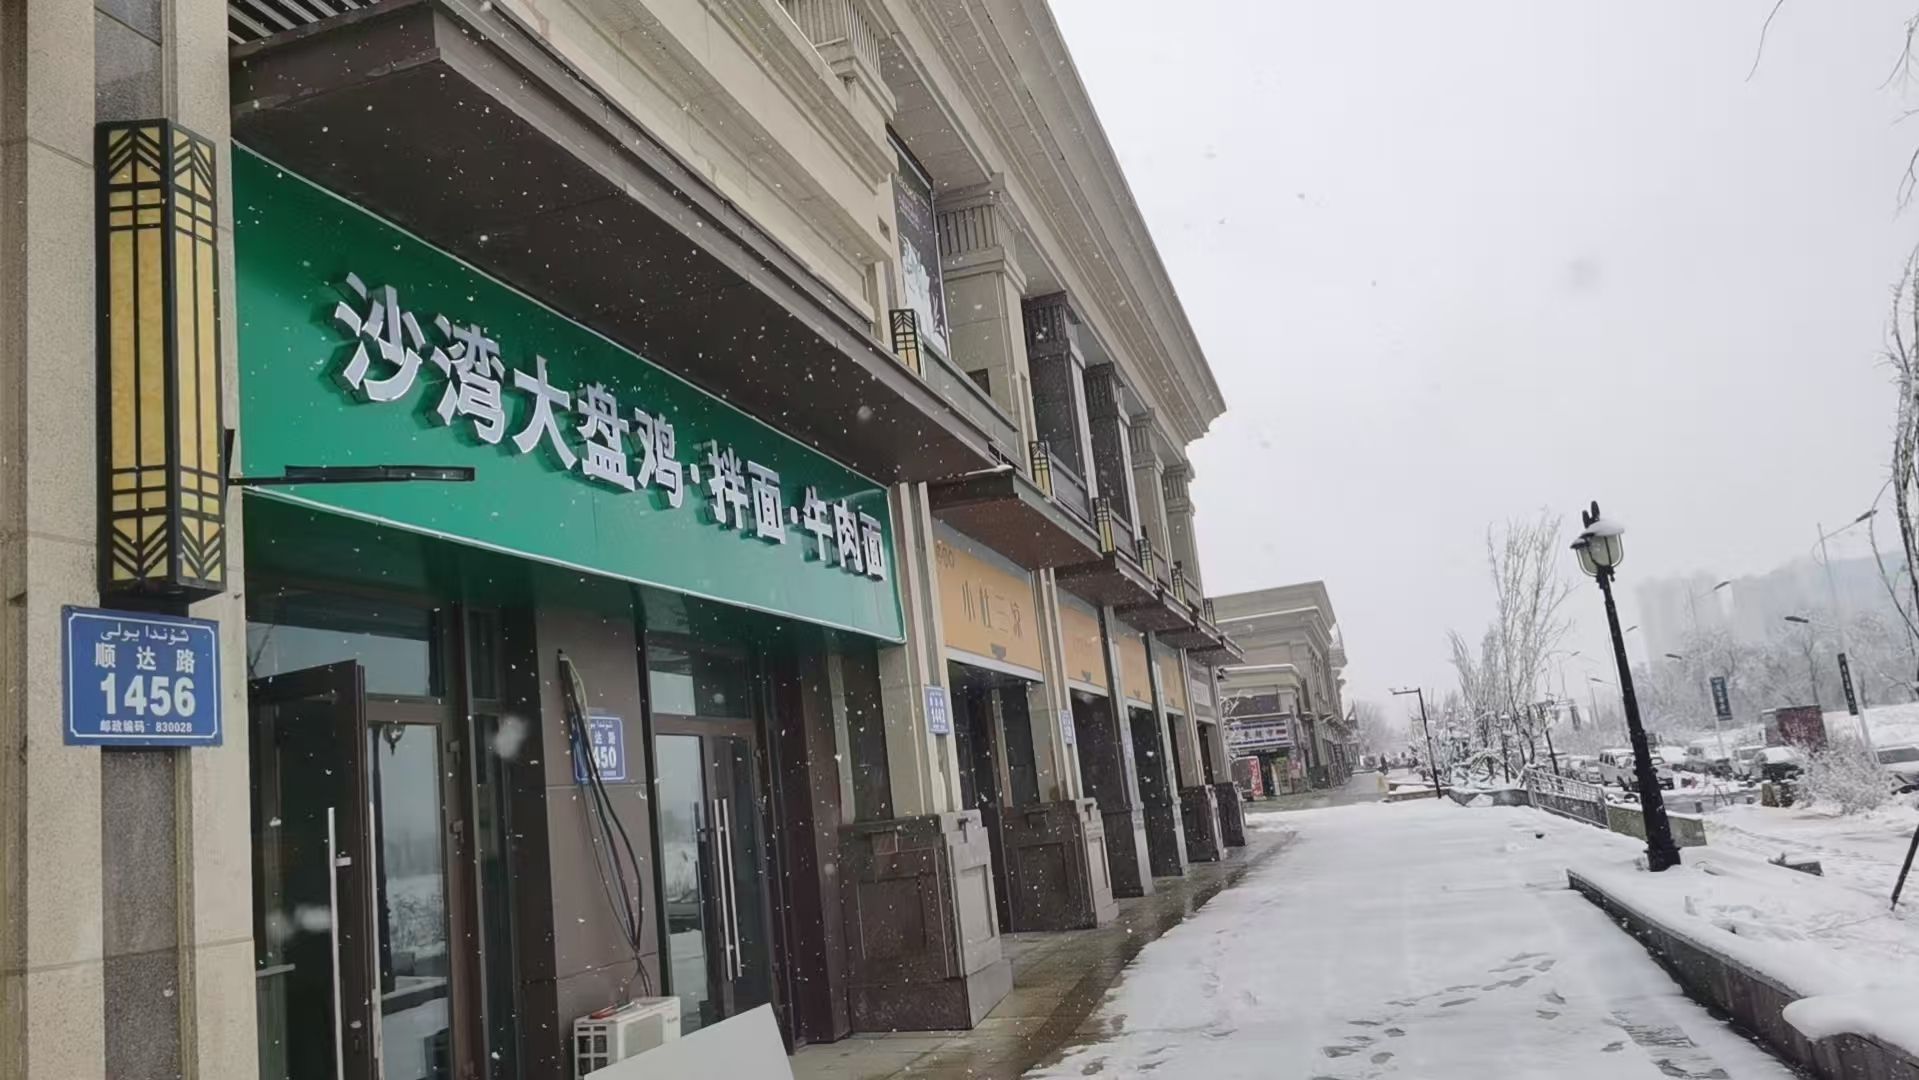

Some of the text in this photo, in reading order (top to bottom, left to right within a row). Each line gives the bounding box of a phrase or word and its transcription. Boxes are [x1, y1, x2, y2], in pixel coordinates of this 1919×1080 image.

[95, 642, 195, 675] 顺达路
[100, 672, 196, 717] 1456
[592, 745, 617, 769] 450
